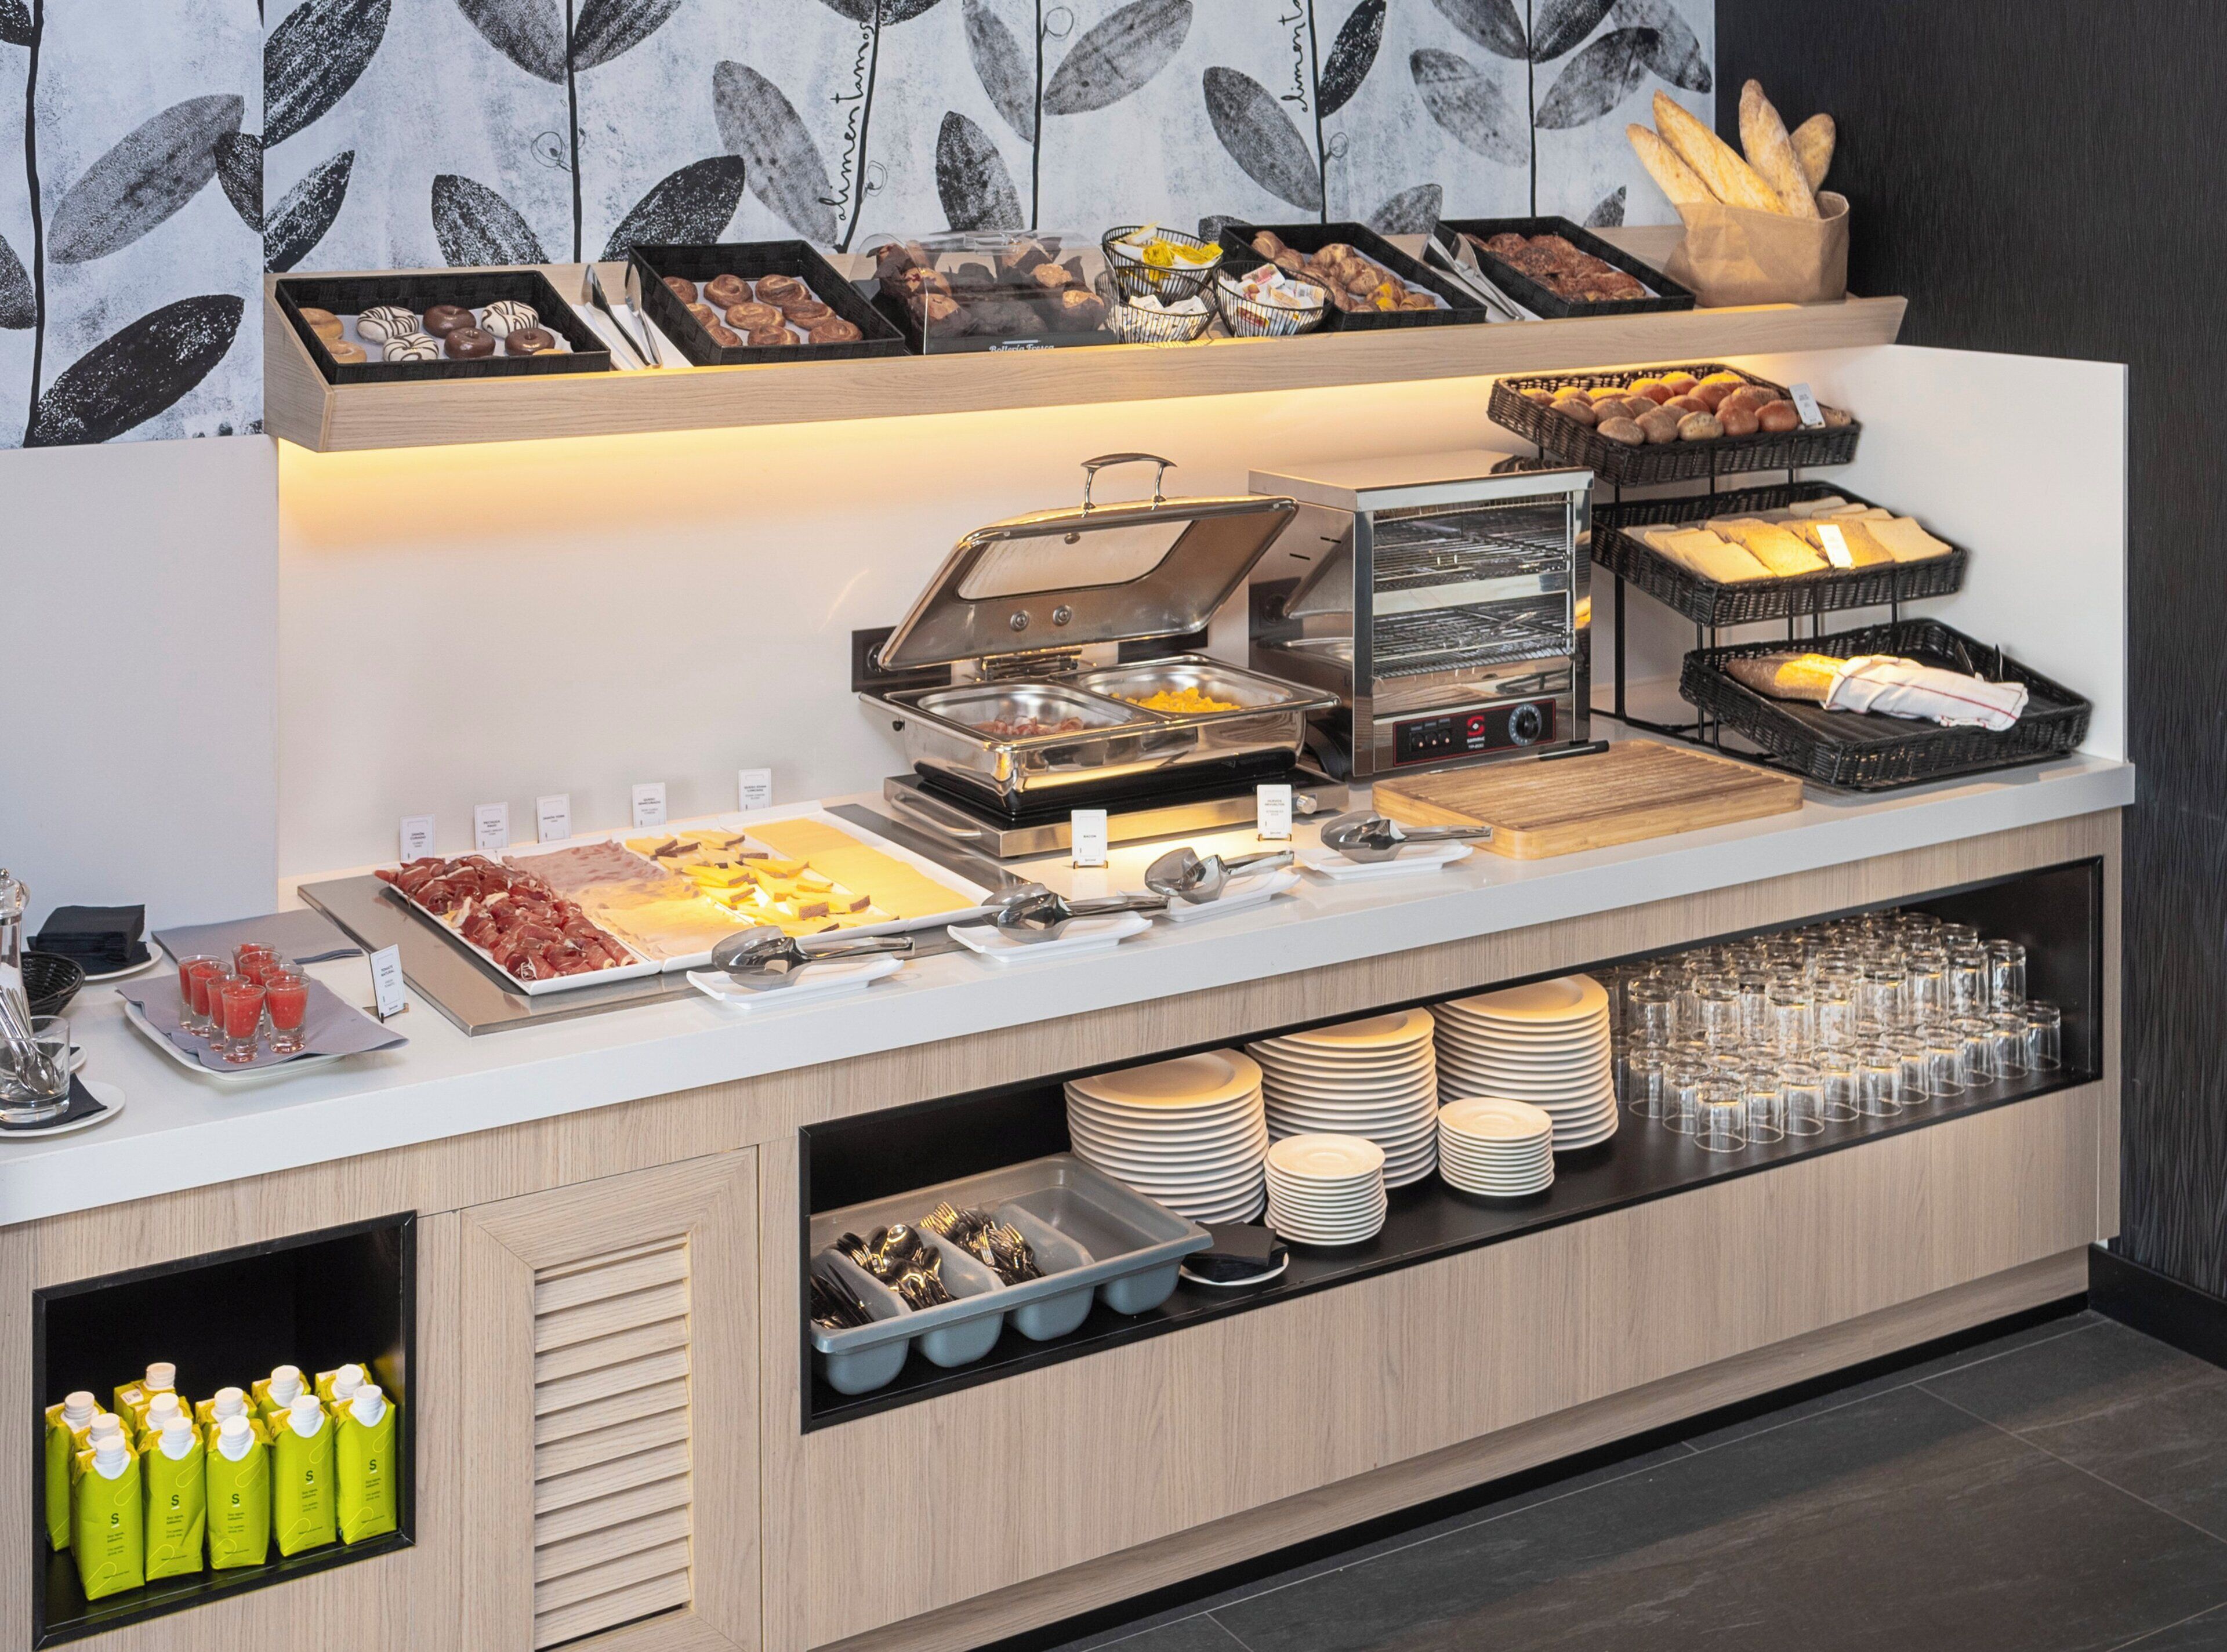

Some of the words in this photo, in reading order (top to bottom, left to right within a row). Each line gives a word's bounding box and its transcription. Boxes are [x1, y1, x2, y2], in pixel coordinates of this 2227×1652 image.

[369, 1459, 377, 1470] S
[306, 1470, 313, 1482] S
[171, 1494, 179, 1506] S
[231, 1494, 240, 1504] S
[111, 1513, 119, 1524] S
